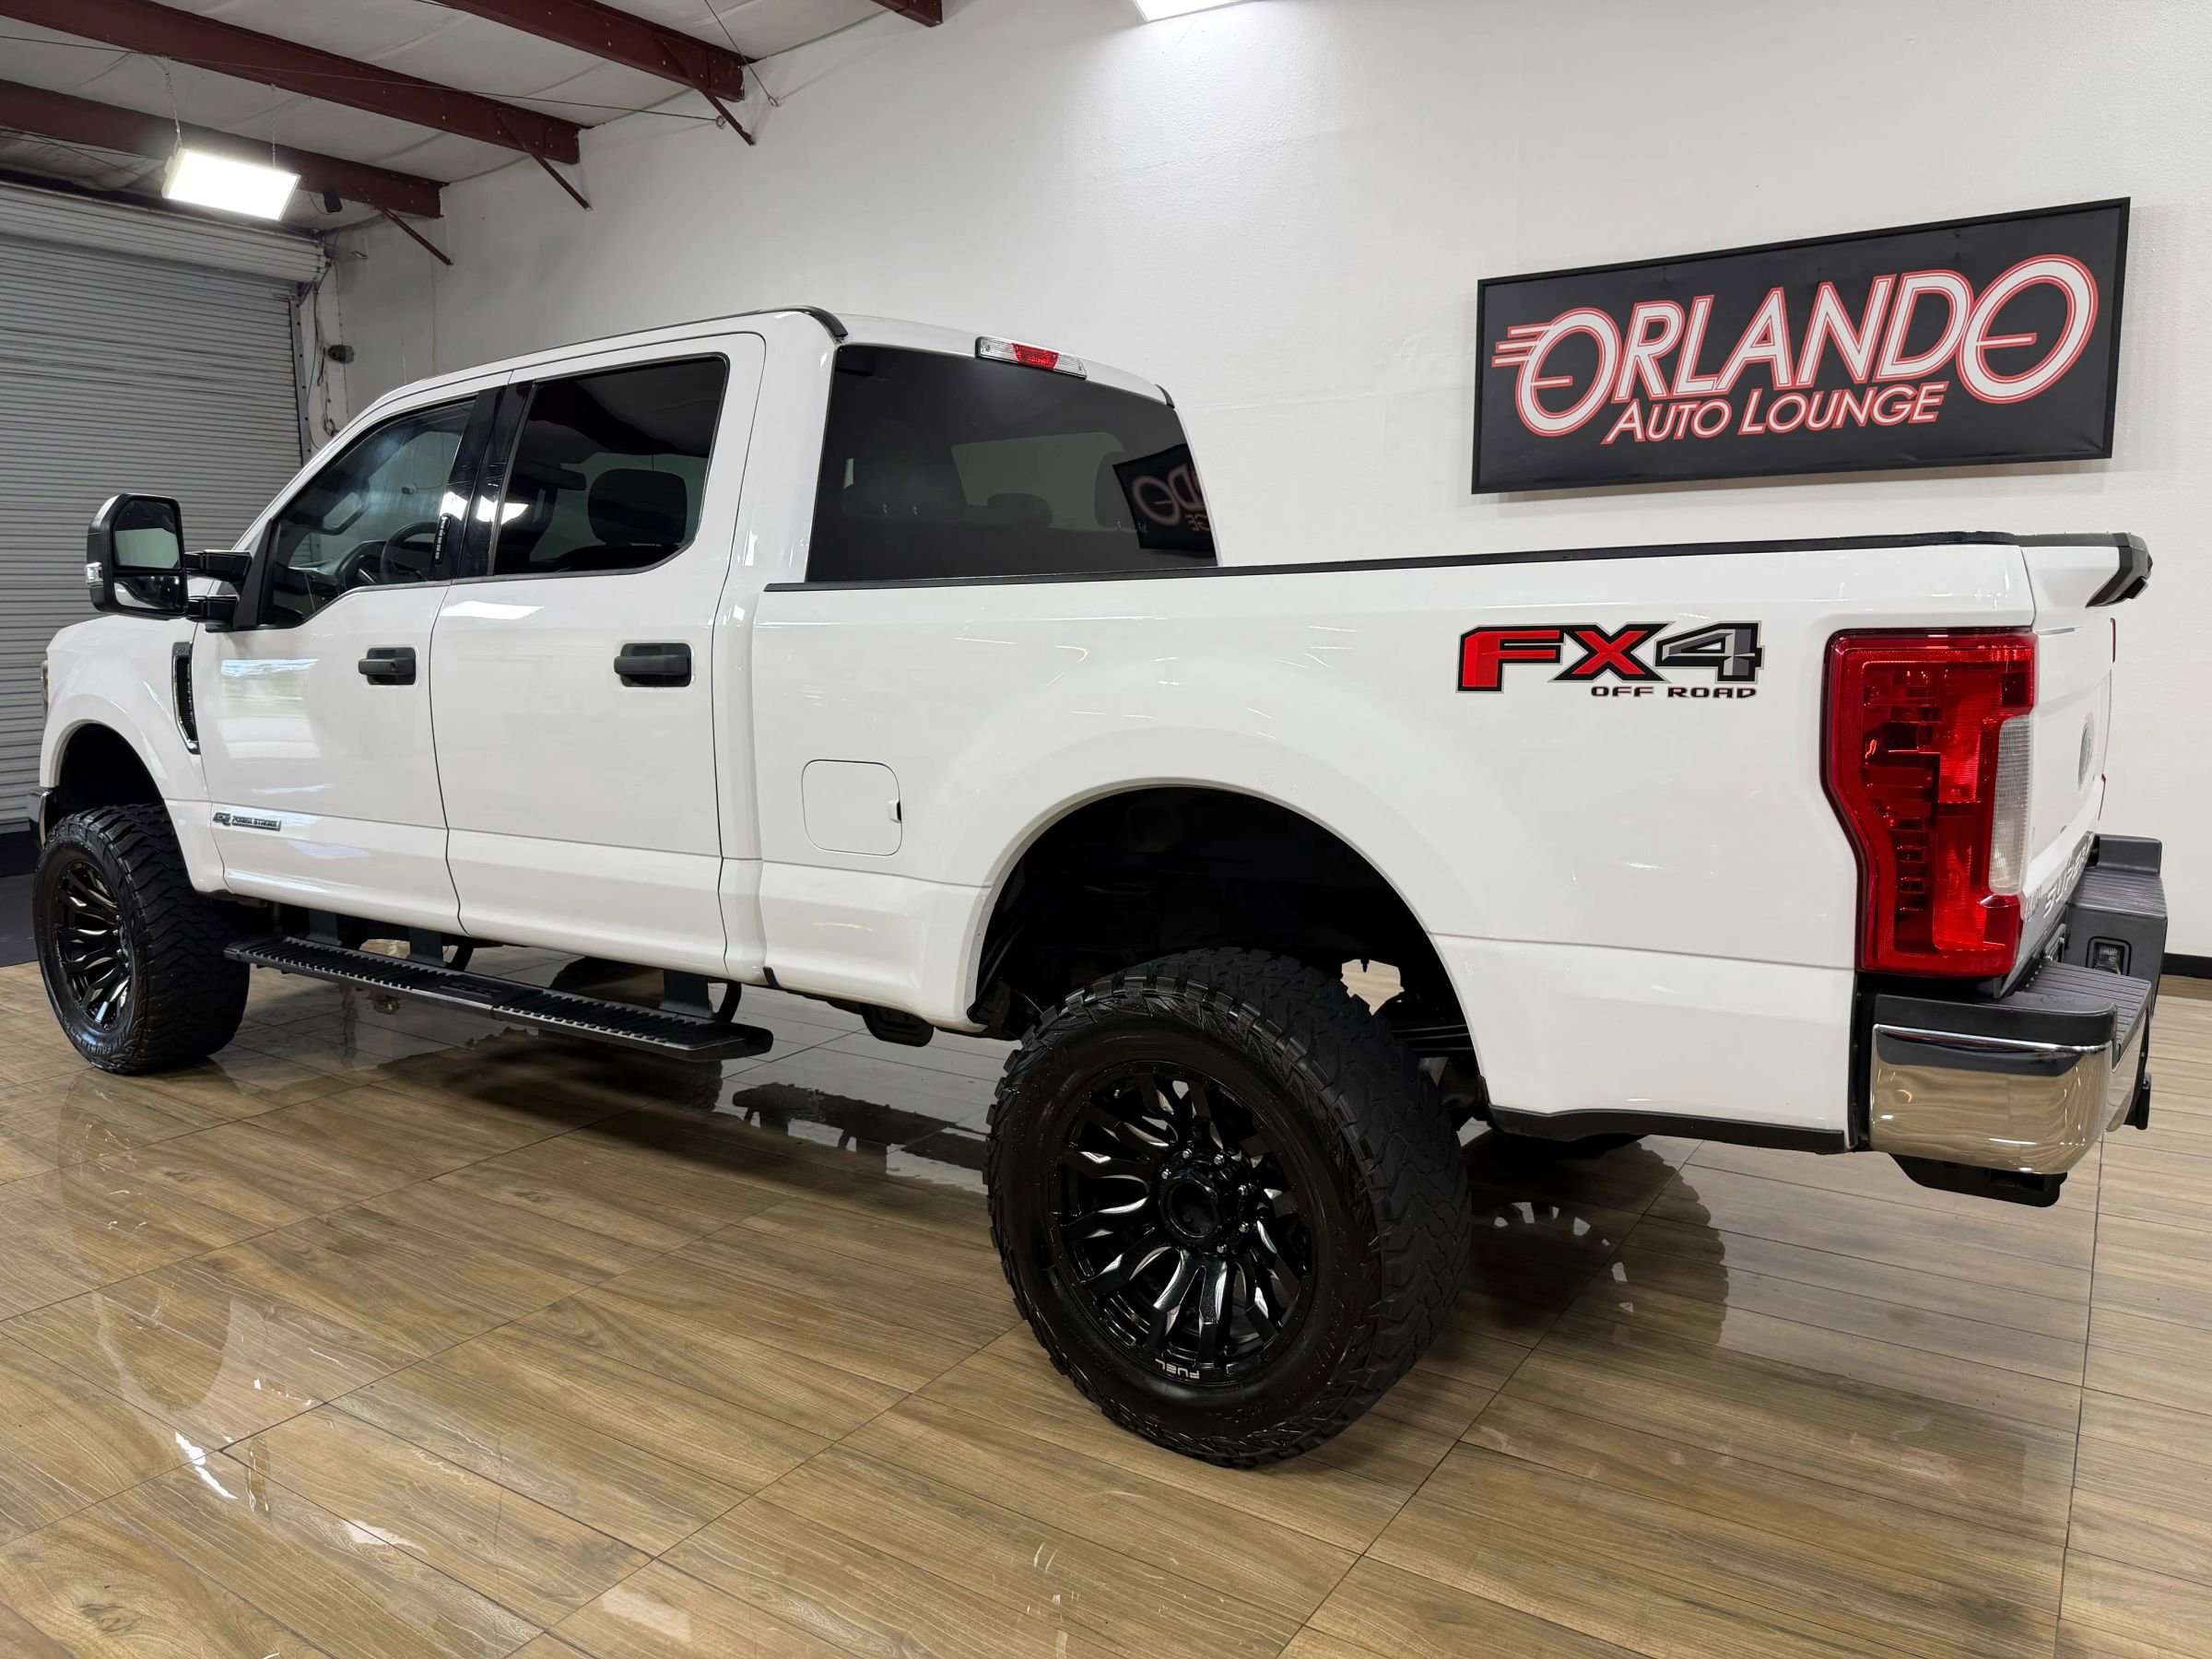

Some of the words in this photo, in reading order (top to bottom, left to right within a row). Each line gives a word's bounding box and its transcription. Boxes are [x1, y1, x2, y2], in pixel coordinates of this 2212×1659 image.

[1512, 254, 2099, 437] ORLANDO
[1602, 397, 1732, 444] AUTO
[1738, 381, 1948, 436] LOUNGE
[1455, 620, 1765, 693] FX4
[1591, 685, 1655, 699] OFF
[1666, 686, 1759, 700] ROAD
[1155, 1358, 1200, 1380] FUEL
